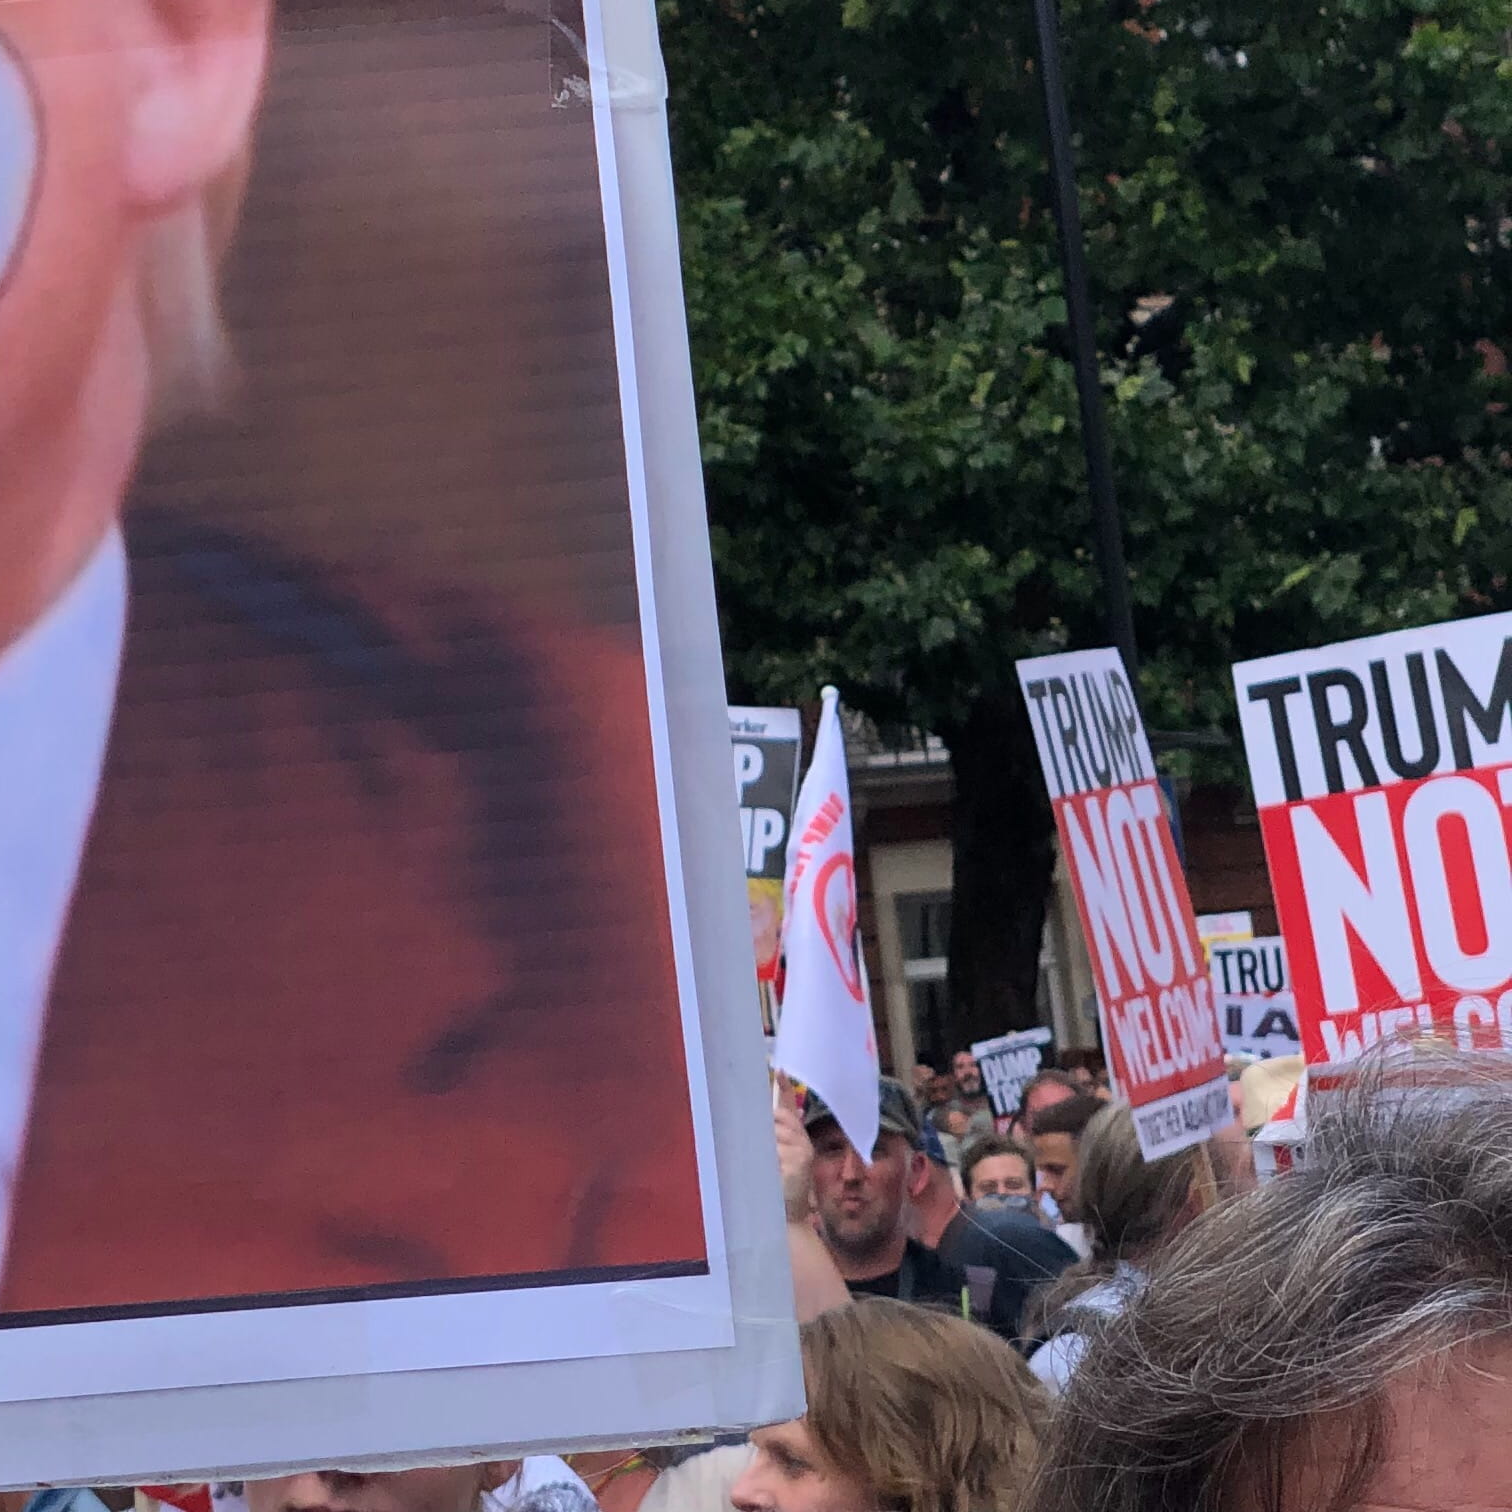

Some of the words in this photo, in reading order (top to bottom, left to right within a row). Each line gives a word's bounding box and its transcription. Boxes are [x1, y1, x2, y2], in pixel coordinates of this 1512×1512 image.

[1026, 669, 1144, 797] TRUMP
[1062, 784, 1197, 999] NOT
[1290, 768, 1512, 1016] NO
